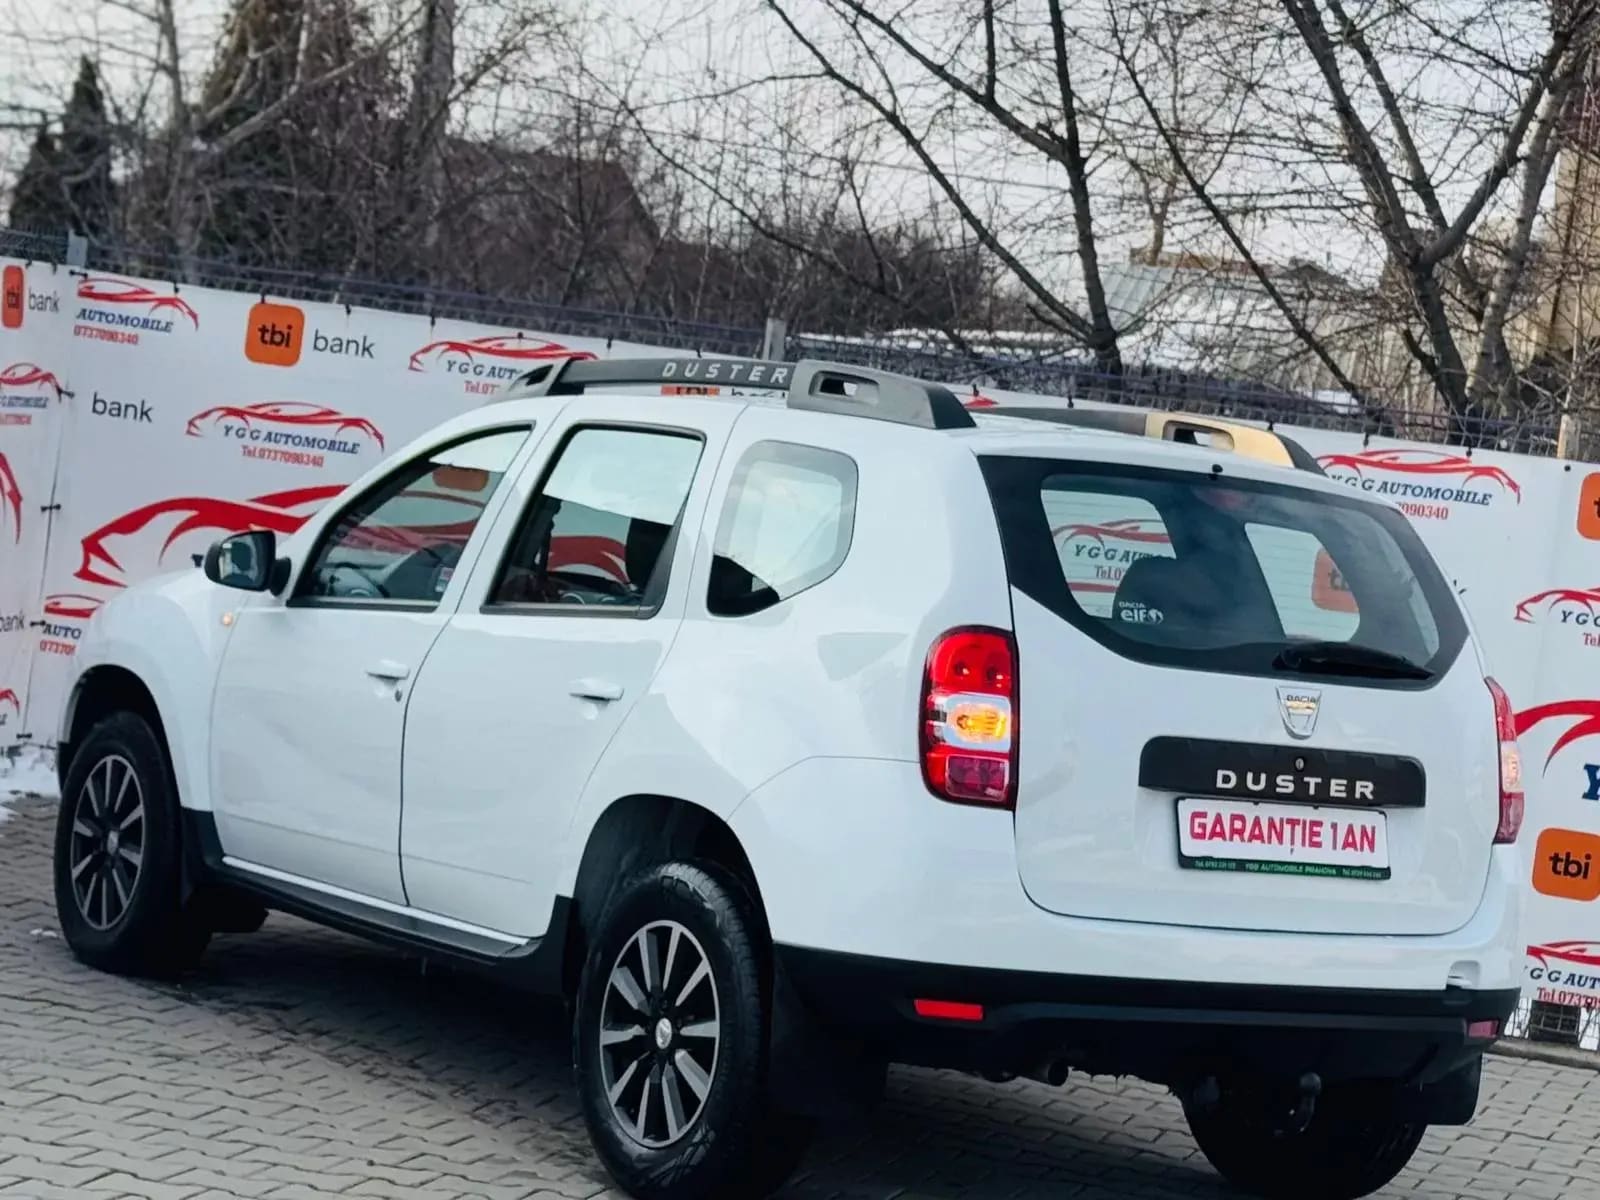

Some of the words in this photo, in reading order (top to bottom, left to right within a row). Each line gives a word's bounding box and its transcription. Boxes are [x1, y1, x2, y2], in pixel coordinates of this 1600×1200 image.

[28, 287, 60, 313] bank
[75, 308, 174, 333] AUTOMOBILE
[257, 323, 294, 348] tbi
[313, 329, 375, 359] bank
[662, 362, 788, 383] DUSTER
[92, 392, 153, 423] bank
[262, 431, 361, 454] AUTOMOBILE
[1376, 480, 1493, 506] AUTOMOBILE
[1216, 769, 1375, 800] DUSTER
[1331, 821, 1339, 851] 1
[1341, 822, 1376, 853] AN
[1549, 851, 1592, 879] tbi
